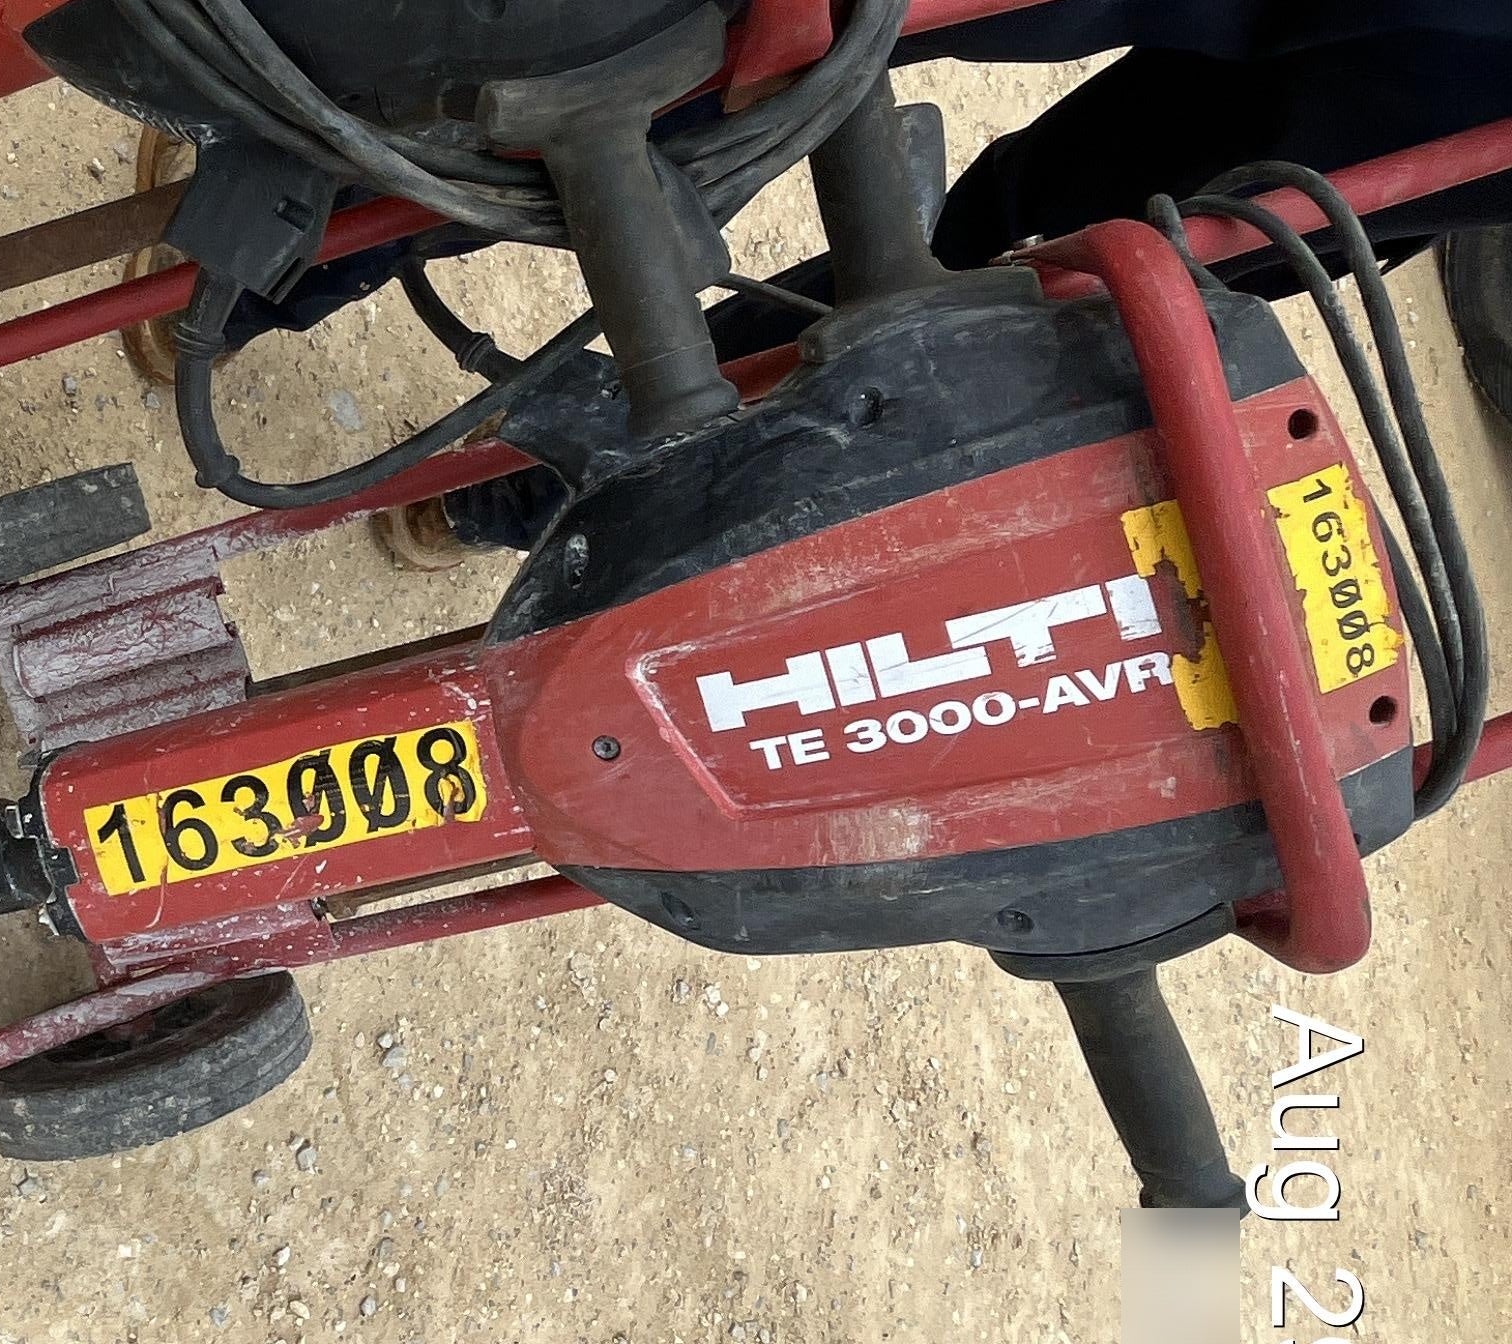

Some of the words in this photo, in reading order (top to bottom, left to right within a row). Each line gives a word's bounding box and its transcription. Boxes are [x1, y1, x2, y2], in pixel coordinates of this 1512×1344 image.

[695, 574, 1163, 733] HILTI
[749, 728, 831, 771] TE
[845, 651, 1174, 754] 3000-AVR
